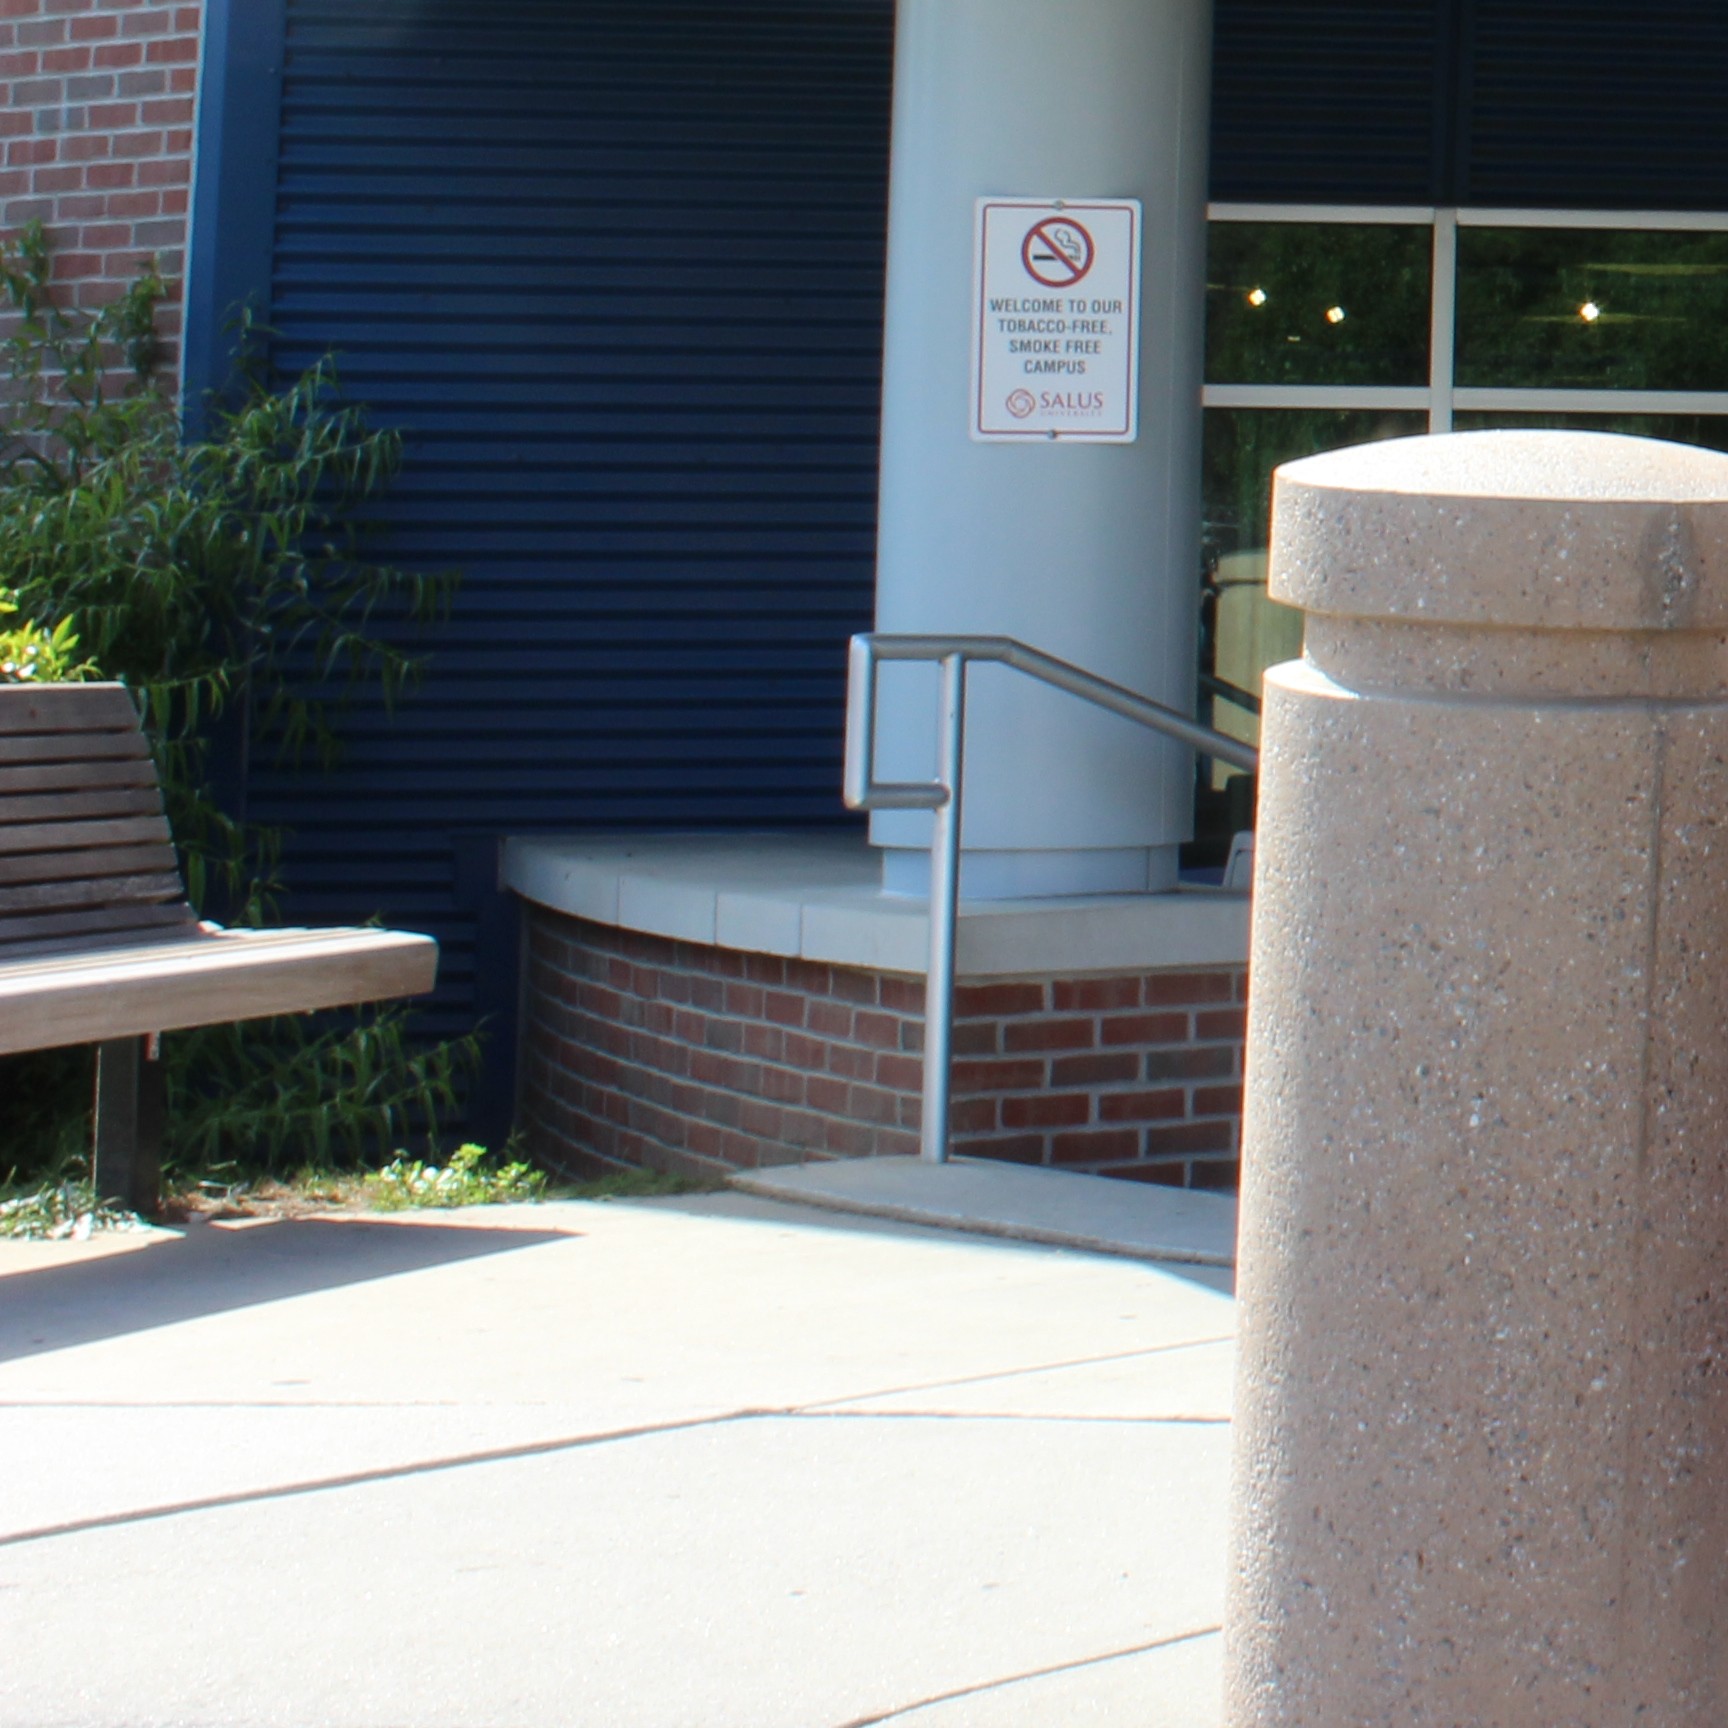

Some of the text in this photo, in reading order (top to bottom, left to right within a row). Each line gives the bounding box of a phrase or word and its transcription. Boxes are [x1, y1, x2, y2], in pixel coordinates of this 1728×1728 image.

[990, 298, 1122, 314] WELCOME TO OUR
[1009, 339, 1101, 354] SMOKE FREE
[1023, 359, 1086, 374] CAMPUS
[1040, 391, 1104, 409] SALUS
